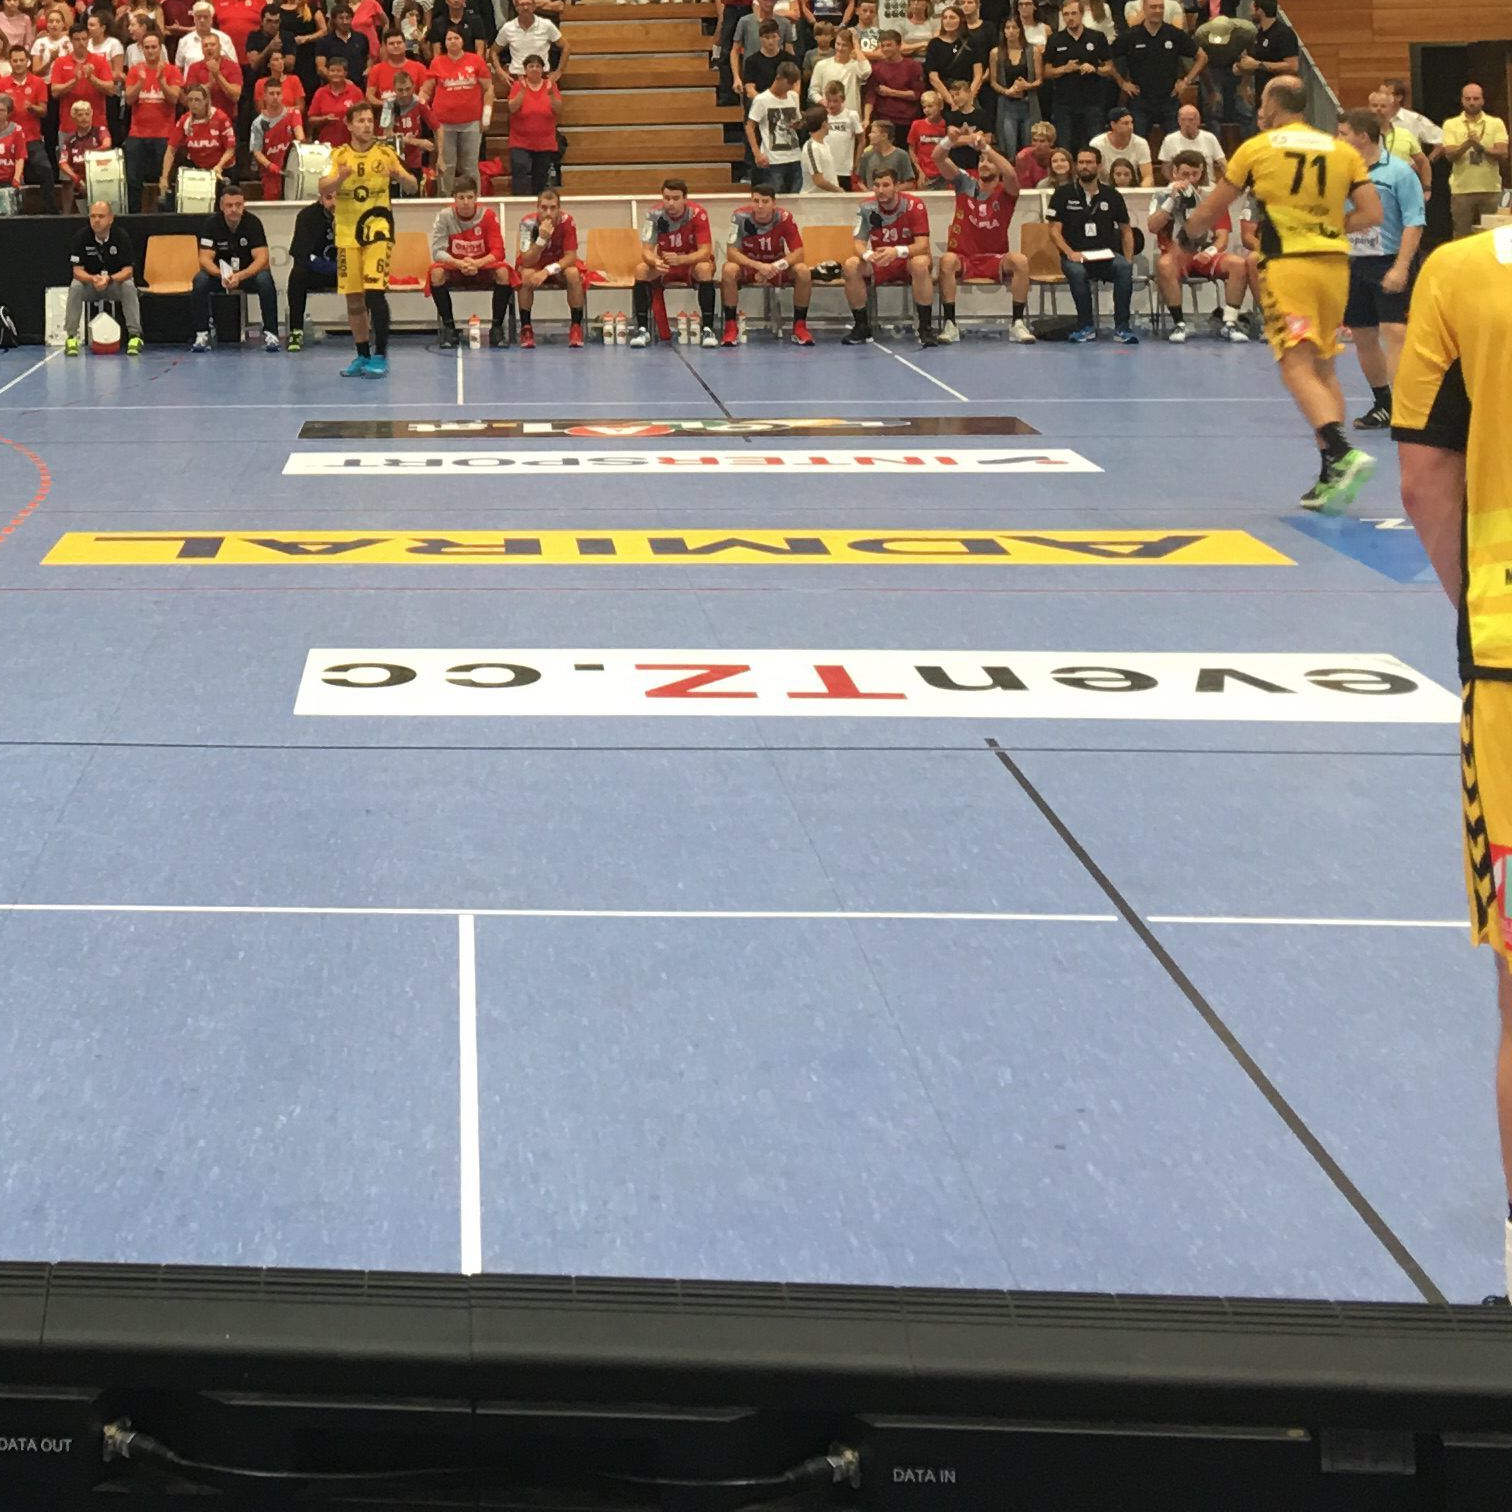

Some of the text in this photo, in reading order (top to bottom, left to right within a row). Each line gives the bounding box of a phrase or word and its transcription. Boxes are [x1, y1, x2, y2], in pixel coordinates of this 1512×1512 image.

[357, 162, 365, 177] 6
[1284, 151, 1327, 199] 71
[758, 237, 772, 251] 11
[376, 258, 385, 274] 6
[324, 455, 959, 468] INTERSPORT
[93, 535, 1207, 559] ADMIRAL
[40, 1437, 73, 1453] OUT
[892, 1467, 956, 1484] DATA IN
